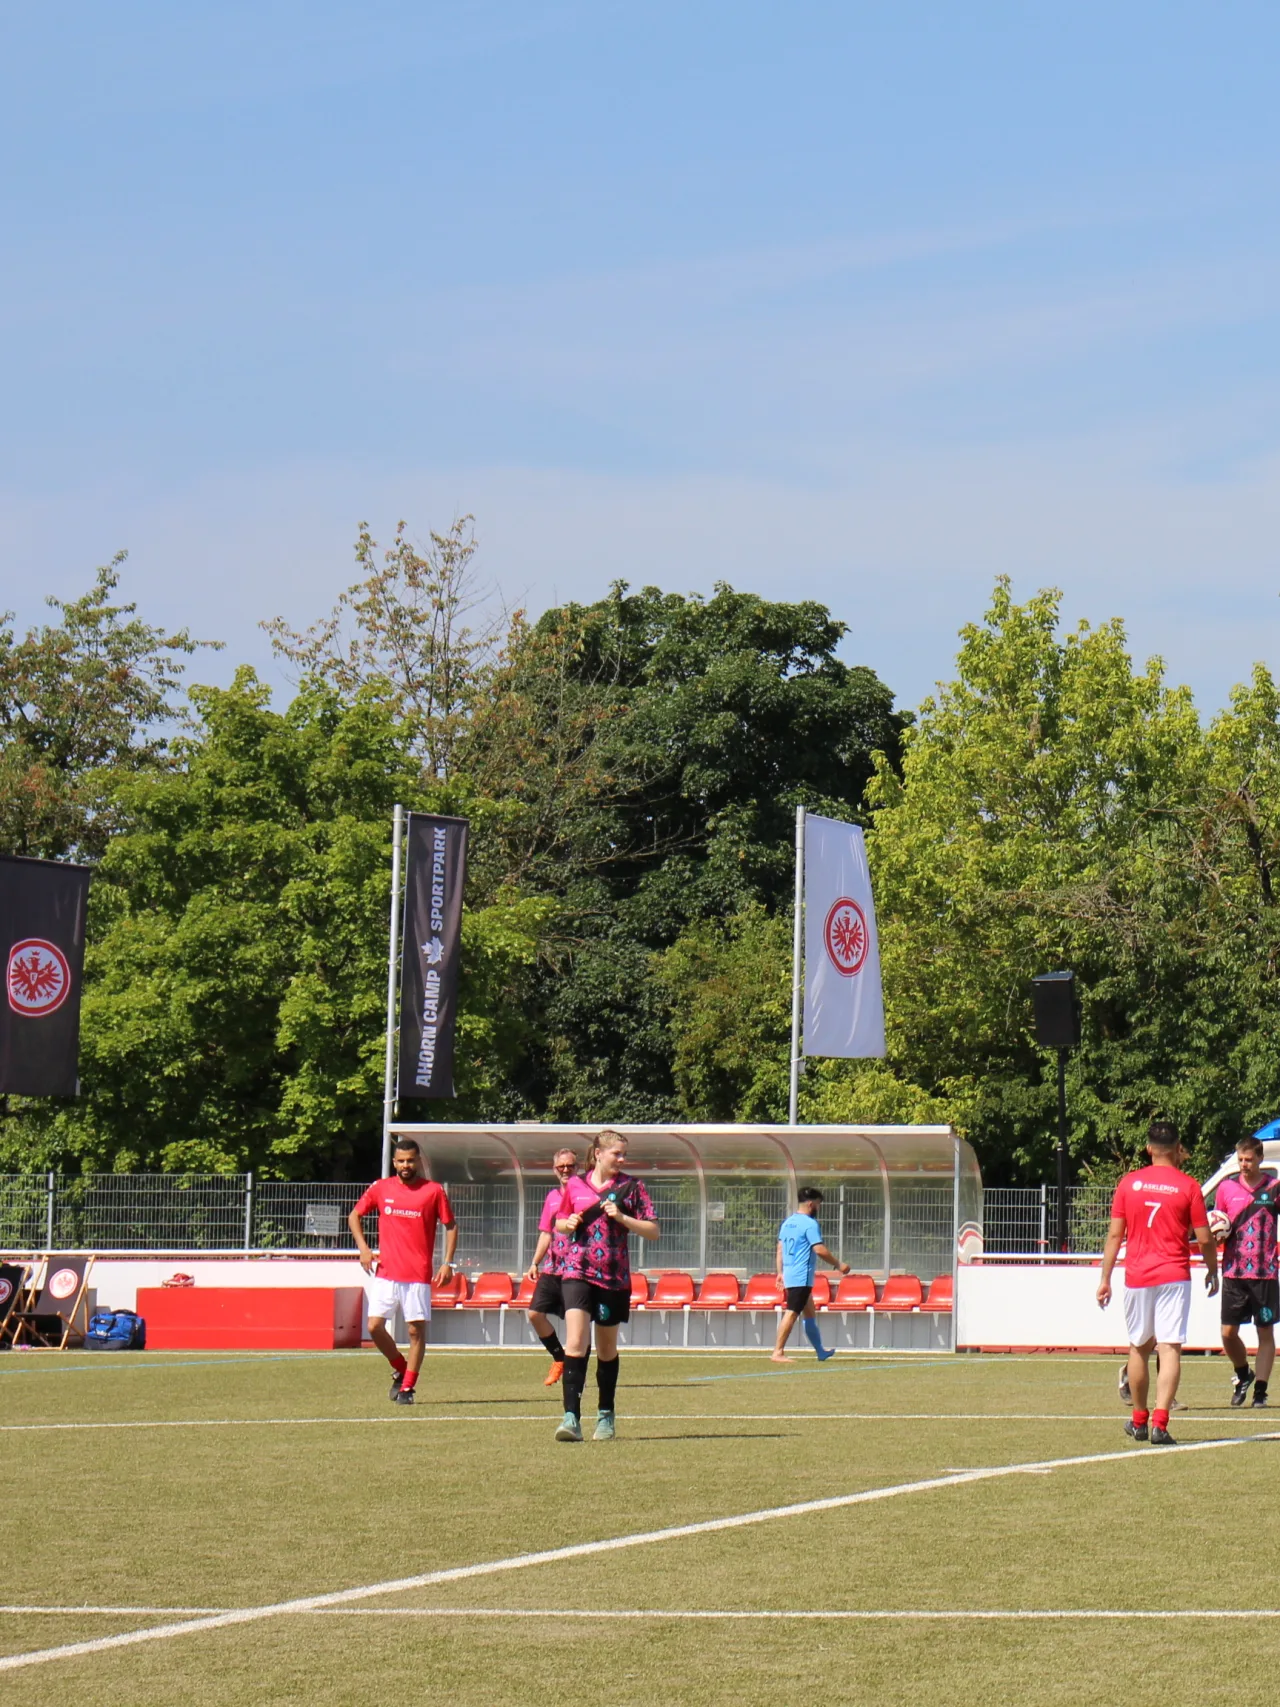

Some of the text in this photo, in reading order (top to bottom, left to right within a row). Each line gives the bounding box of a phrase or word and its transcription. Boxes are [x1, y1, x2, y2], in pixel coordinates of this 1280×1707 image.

[415, 826, 446, 1088] AHORN CAMP SPORTPARK
[1142, 1183, 1179, 1193] ASKLEPIOS
[393, 1208, 422, 1217] ASKLEPIOS
[1144, 1201, 1162, 1228] 7
[783, 1237, 795, 1256] 12
